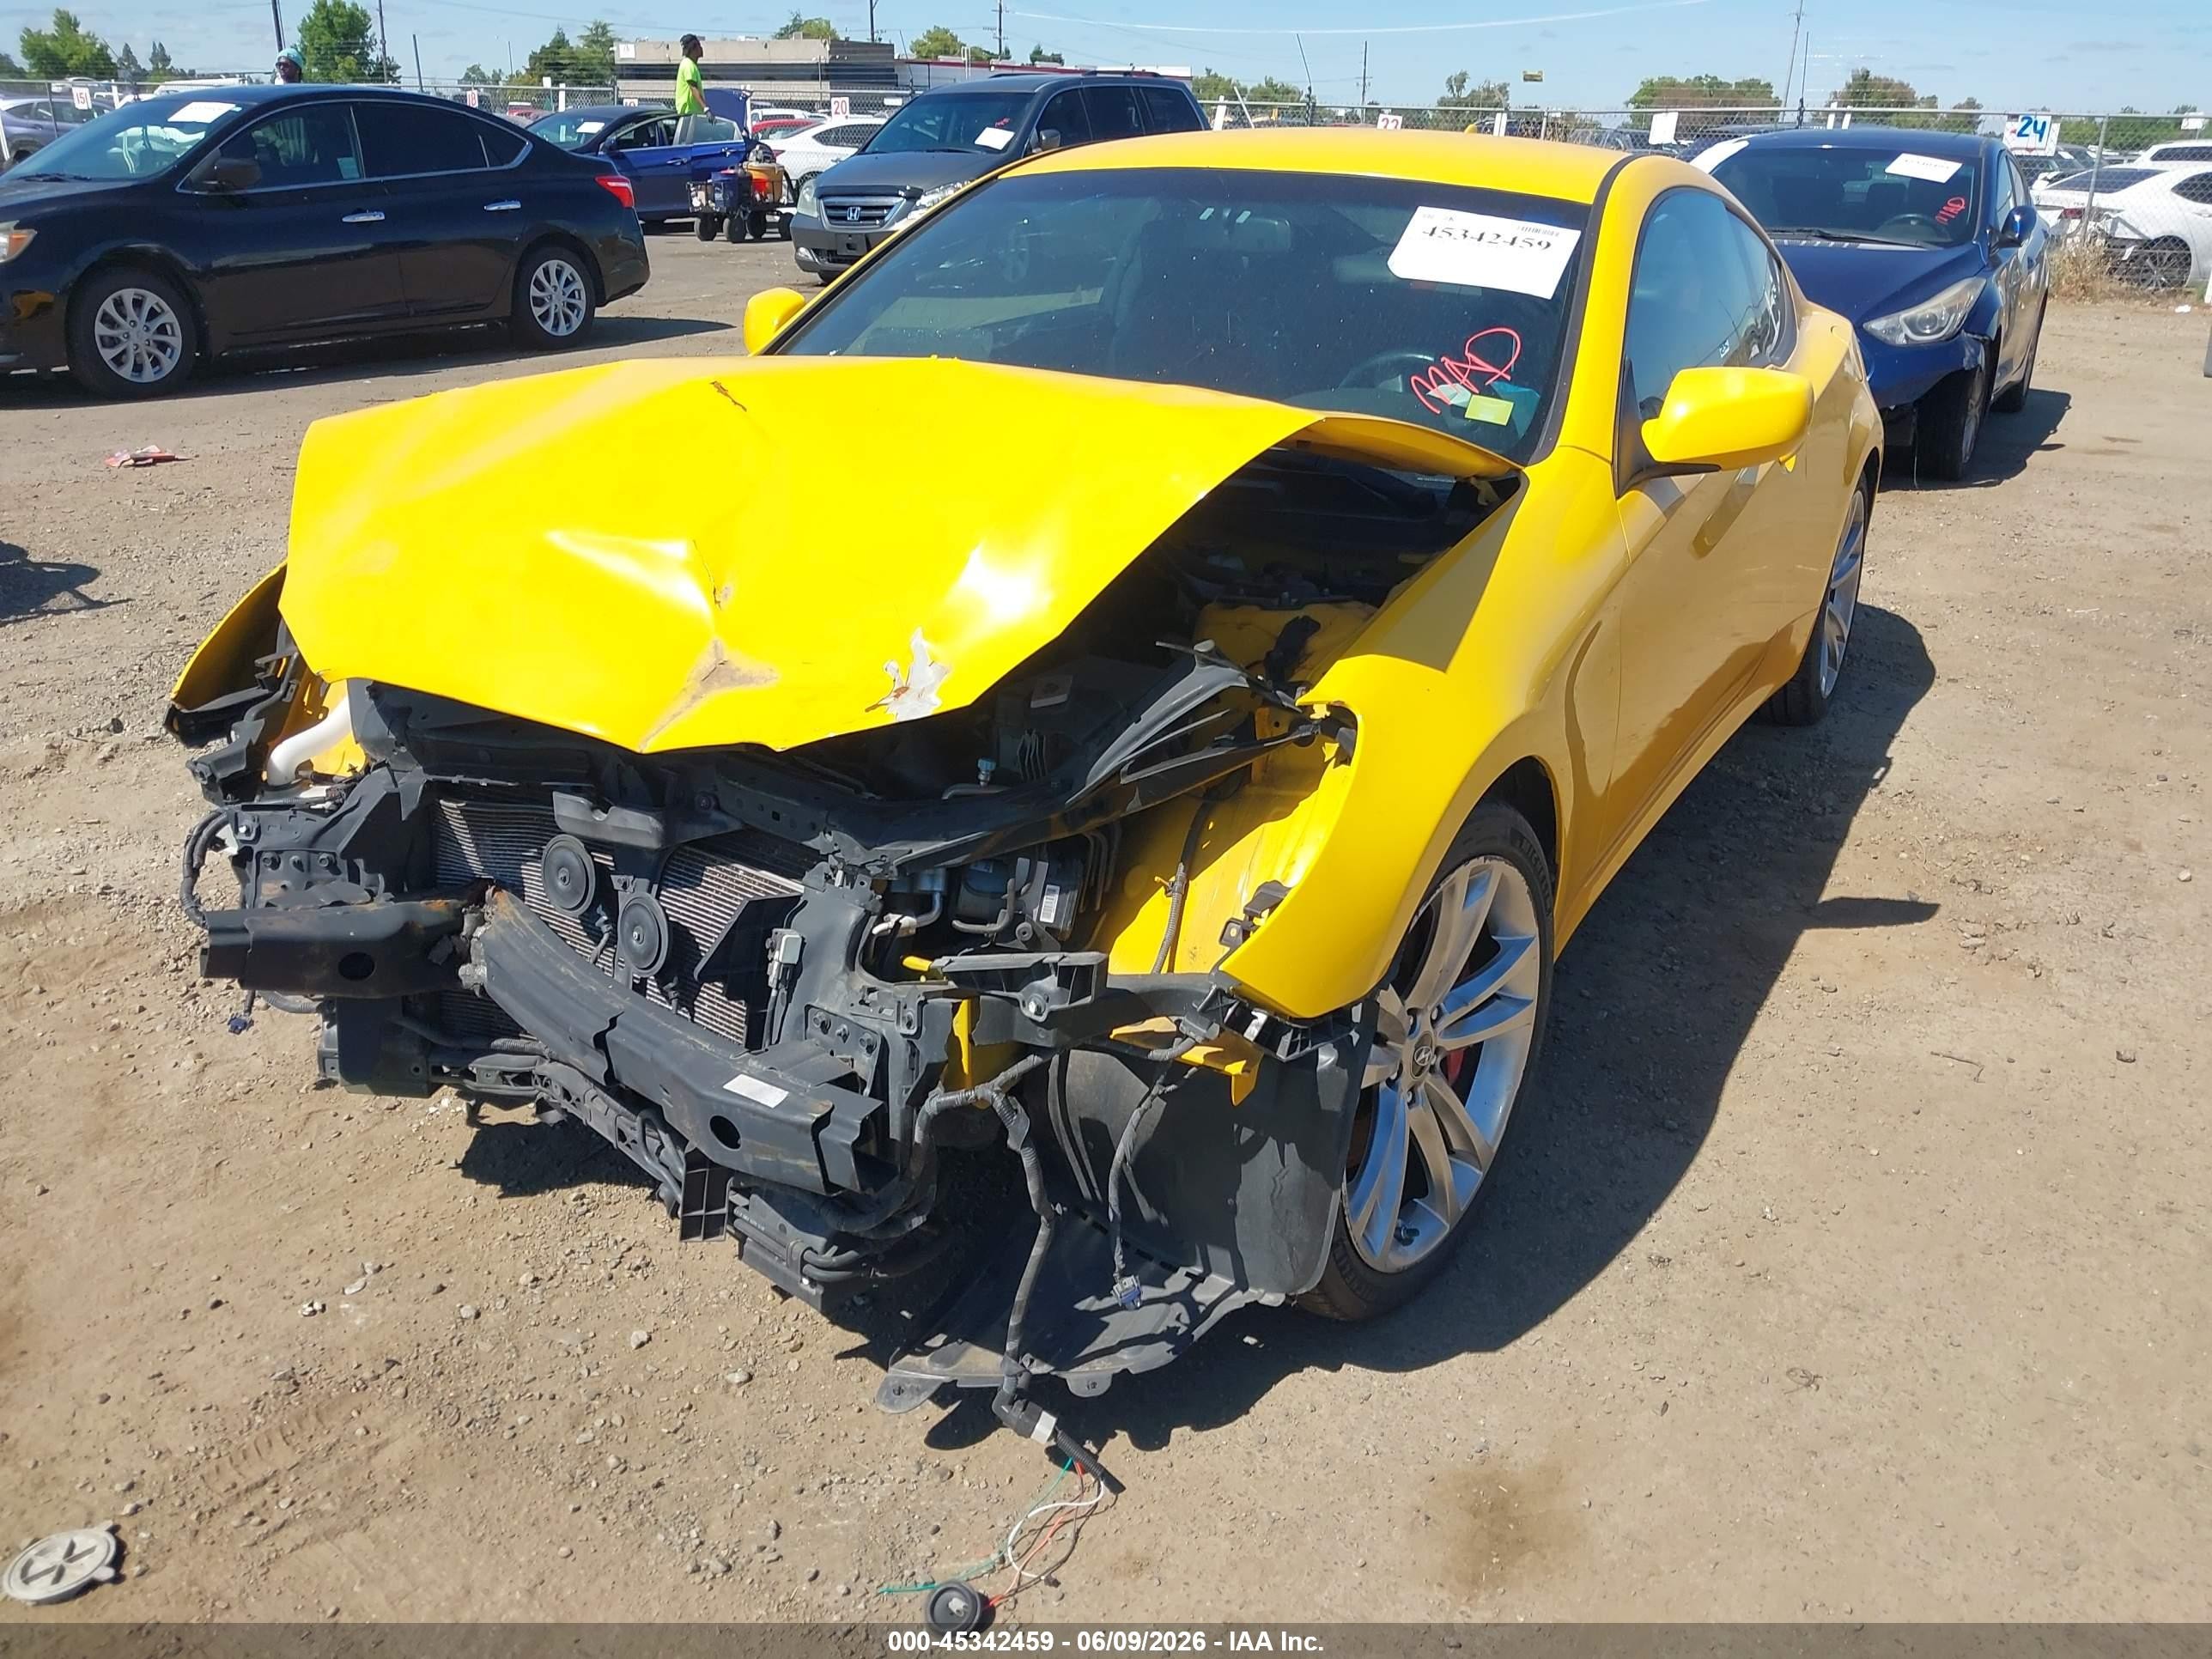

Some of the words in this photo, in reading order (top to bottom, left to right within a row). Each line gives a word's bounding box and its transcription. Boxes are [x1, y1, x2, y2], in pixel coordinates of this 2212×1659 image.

[833, 100, 848, 115] 20
[2016, 115, 2047, 143] 24
[1422, 226, 1552, 251] 45342459
